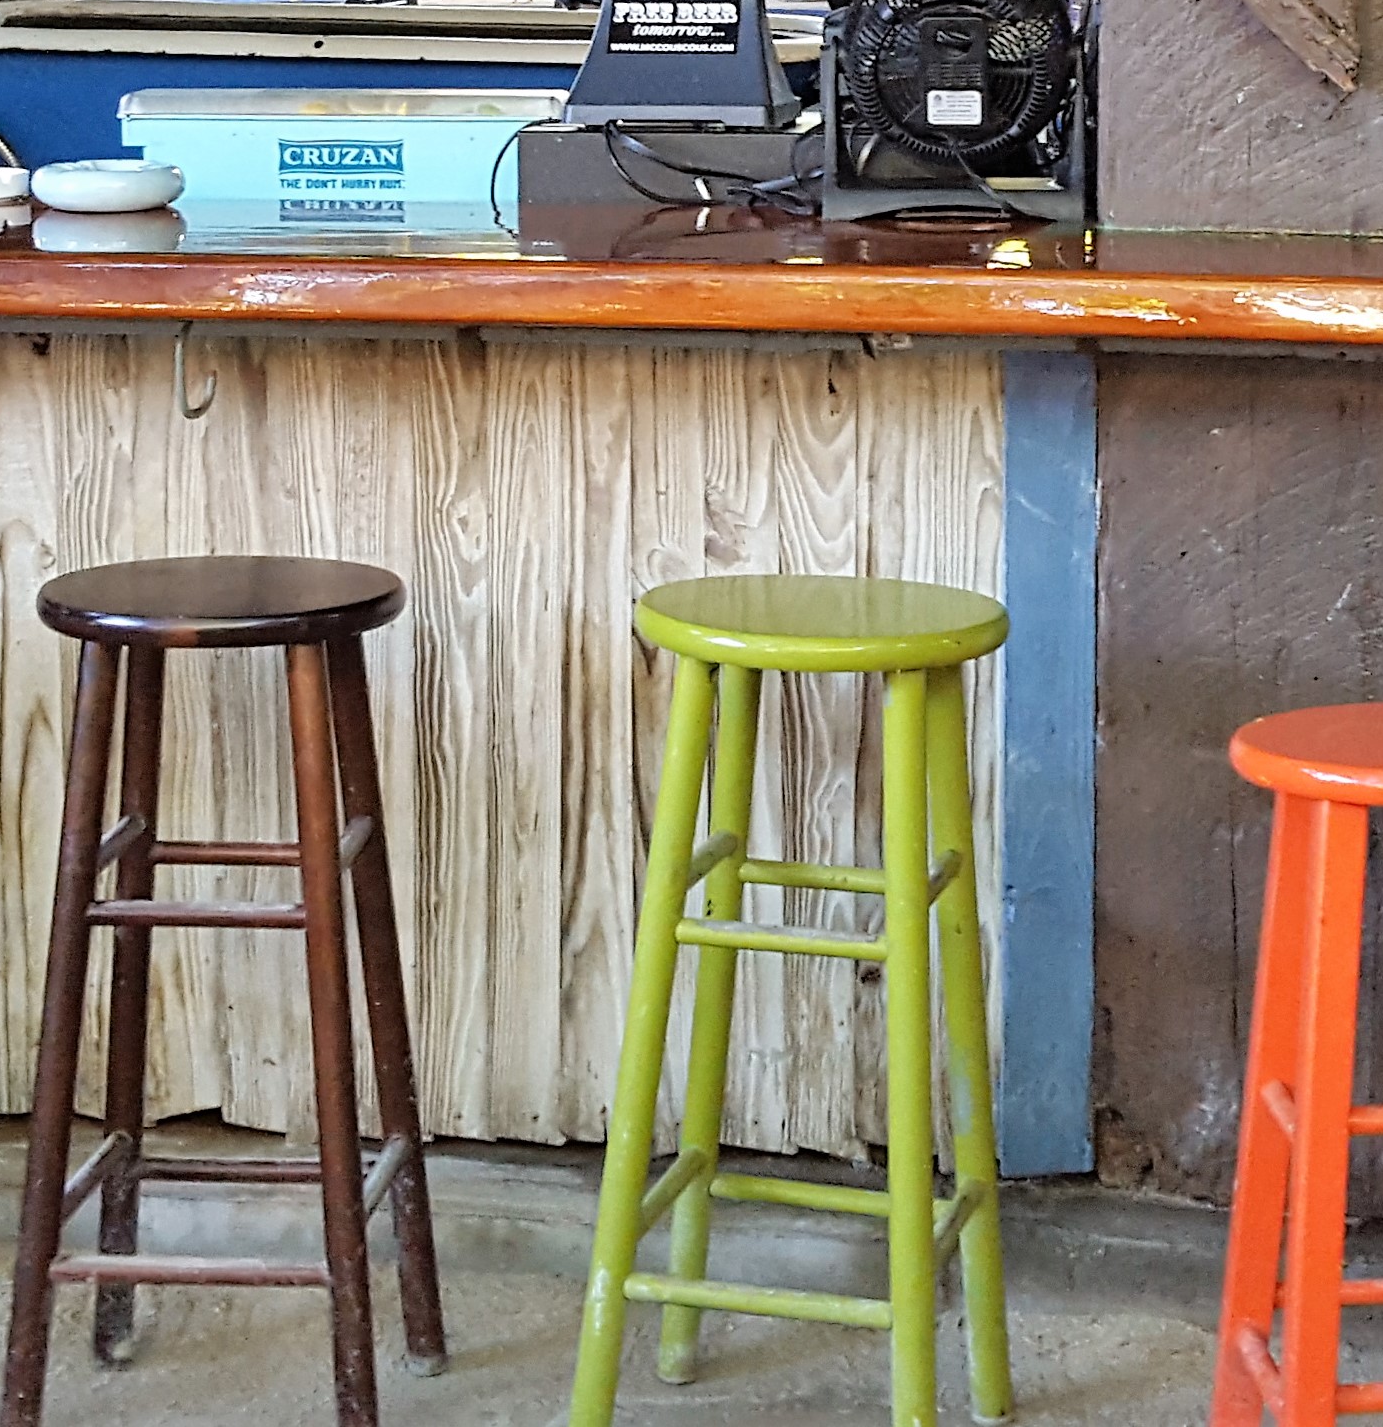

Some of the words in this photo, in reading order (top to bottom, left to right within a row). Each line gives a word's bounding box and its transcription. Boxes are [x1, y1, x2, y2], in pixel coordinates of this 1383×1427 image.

[613, 2, 674, 23] FREE
[675, 2, 738, 24] BEER
[283, 147, 399, 166] CRUZAN
[280, 179, 302, 189] THE
[306, 179, 337, 189] DON'T
[341, 179, 377, 189] HURRY
